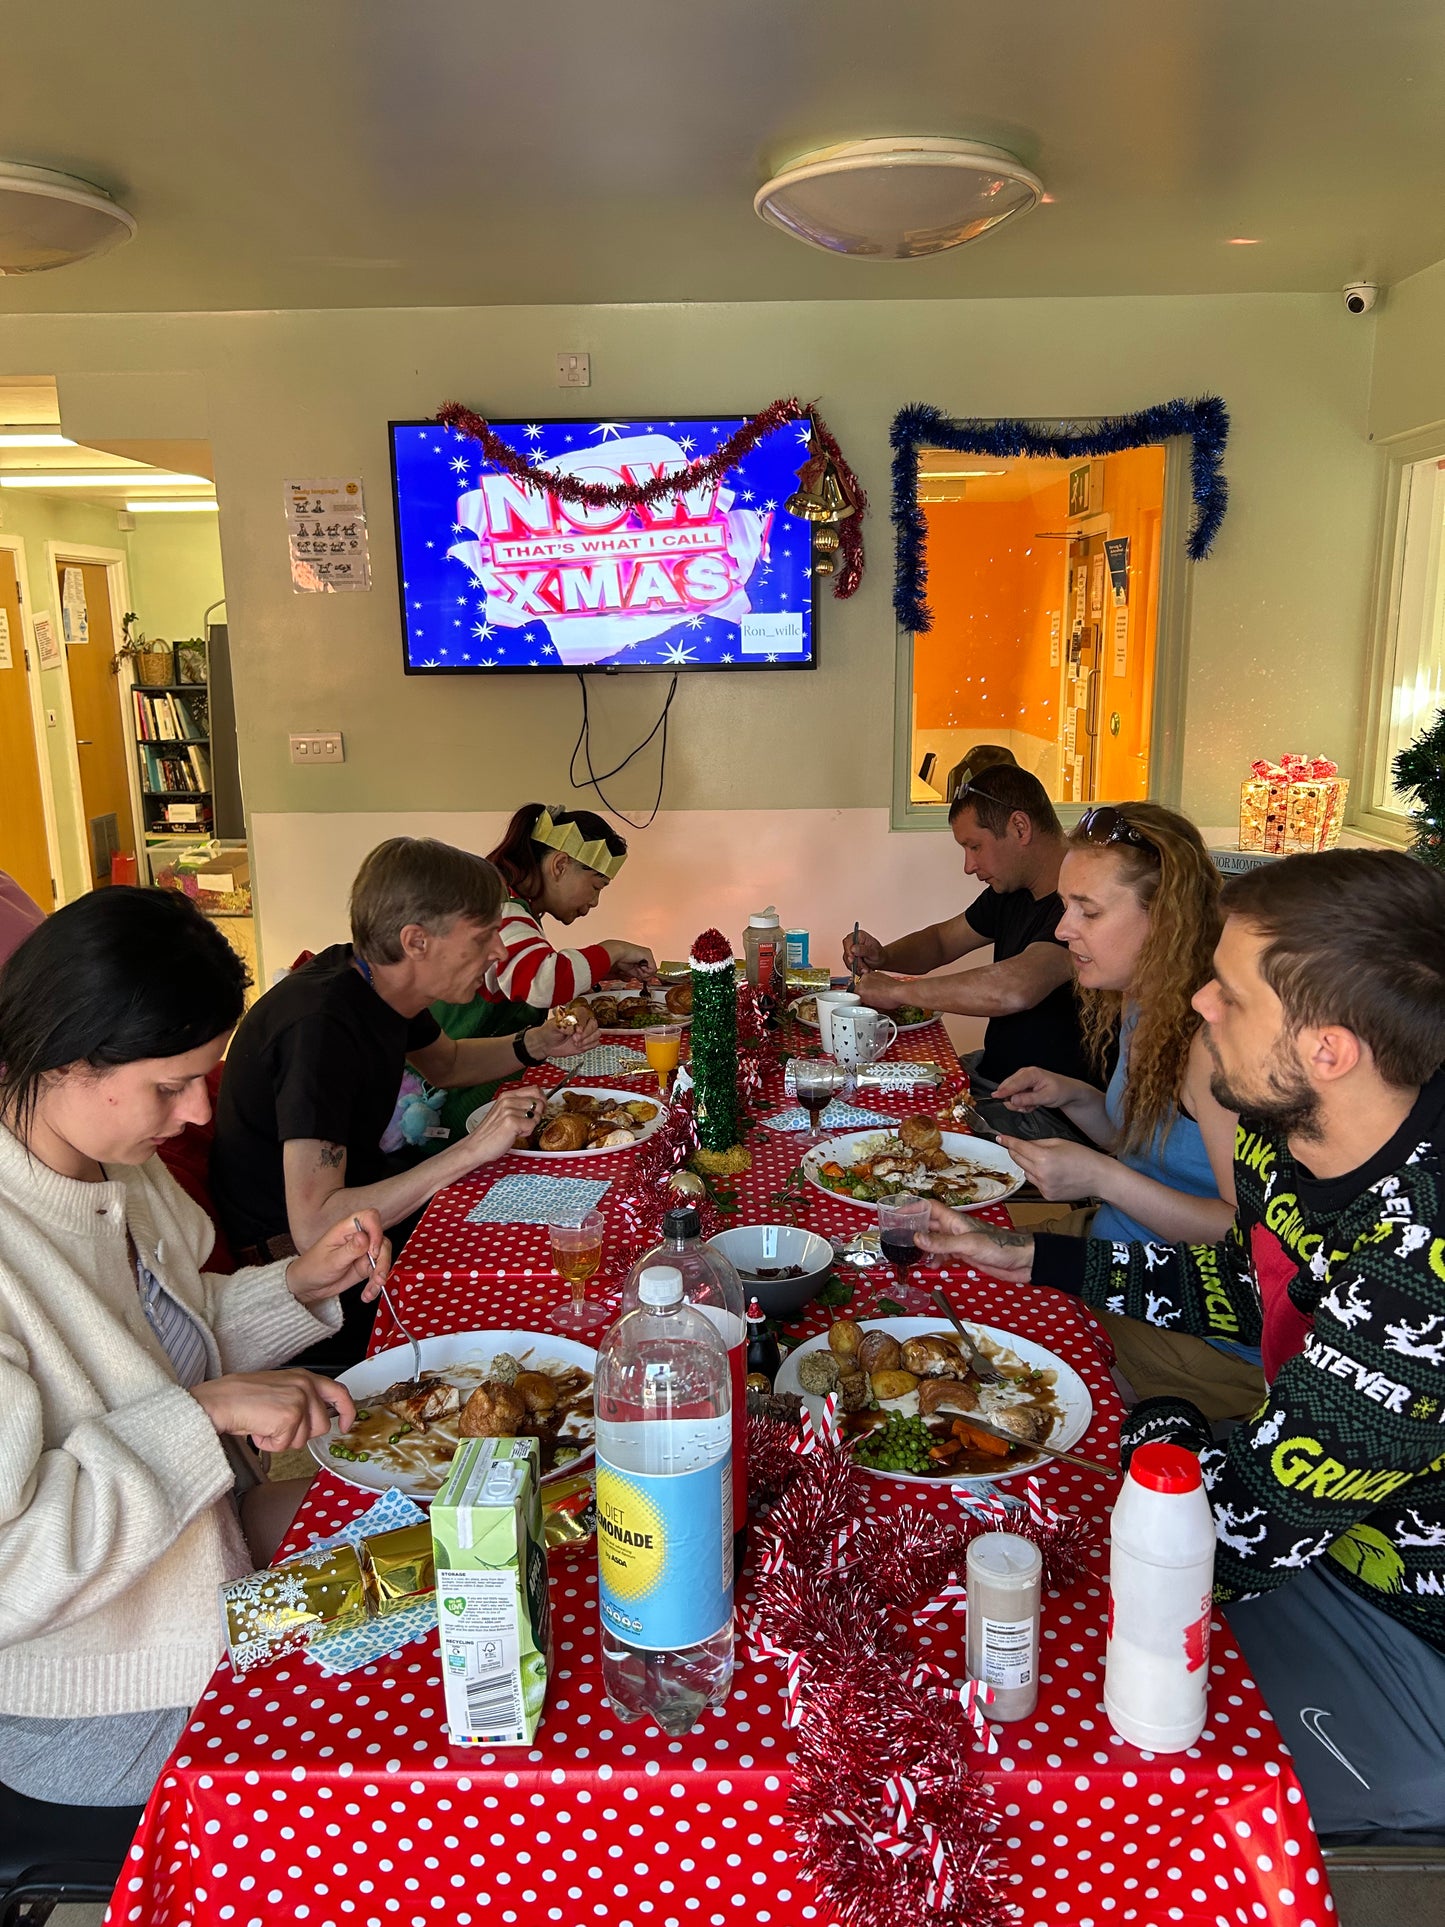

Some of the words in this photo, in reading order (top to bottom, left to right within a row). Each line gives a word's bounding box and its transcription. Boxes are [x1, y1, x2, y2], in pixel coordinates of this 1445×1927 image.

[481, 459, 721, 533] NOW
[503, 543, 574, 558] THAT'S
[581, 538, 641, 552] WHAT
[649, 534, 655, 547] I
[662, 532, 716, 546] CALL
[492, 556, 734, 614] XMAS
[1210, 856, 1230, 868] NIOR
[1234, 1122, 1277, 1182] RINC
[1265, 1192, 1325, 1263] GRINC
[1189, 1243, 1240, 1332] RINCH
[1302, 1334, 1412, 1414] ATEVER
[1270, 1435, 1414, 1504] GRINCH
[597, 1508, 654, 1550] MONADE
[605, 1501, 625, 1526] DIET
[611, 1554, 628, 1568] ASDA
[448, 1602, 465, 1611] LOVE
